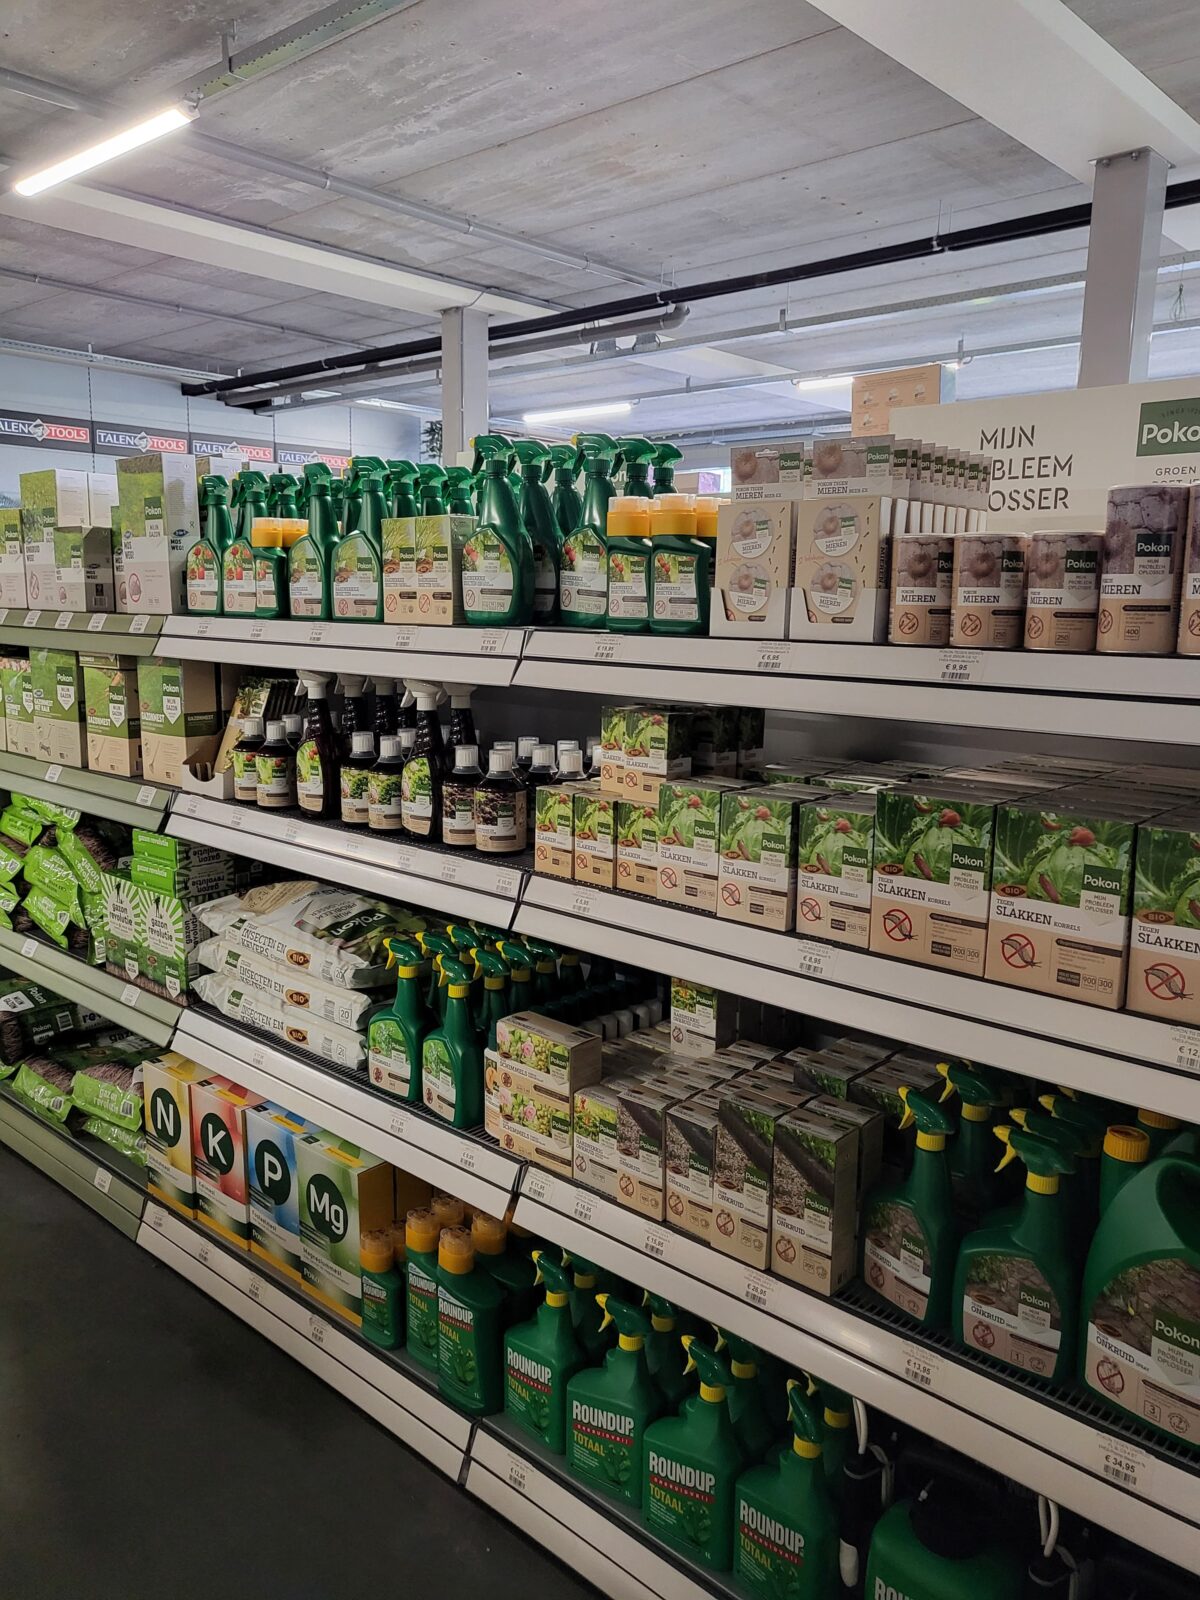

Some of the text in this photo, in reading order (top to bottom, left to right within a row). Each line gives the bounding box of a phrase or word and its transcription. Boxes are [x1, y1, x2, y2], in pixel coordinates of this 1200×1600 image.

[0, 421, 87, 440] ALEN TOOLS
[98, 432, 185, 451] TALEN TOOLS
[980, 424, 1036, 451] MIJN
[193, 443, 271, 459] TALEN TOOLS
[867, 453, 889, 461] Pokon
[280, 452, 309, 464] TALEN
[780, 459, 800, 468] Pokon
[991, 453, 1073, 481] BLEEM
[1155, 465, 1197, 476] GROEN
[735, 491, 764, 500] MIEREN
[817, 486, 848, 495] MIEREN
[988, 487, 1069, 512] OSSER
[145, 506, 161, 516] Pokon
[825, 541, 848, 549] MIEREN
[1137, 542, 1170, 553] Pokon
[399, 552, 415, 560] Pokon
[433, 551, 448, 560] Pokon
[484, 551, 500, 560] Pokon
[583, 551, 600, 560] Pokon
[1066, 559, 1096, 569] Pokon
[1101, 585, 1142, 595] MIEREN
[820, 598, 842, 607] MIEREN
[901, 594, 936, 603] MIEREN
[963, 595, 1000, 604] MIEREN
[1030, 596, 1063, 605] MIEREN
[1125, 628, 1139, 636] 400
[952, 664, 968, 672] 9,95
[56, 673, 73, 682] Pokon
[162, 683, 180, 693] Pokon
[109, 692, 124, 701] Pokon
[650, 741, 665, 749] Pokon
[601, 753, 622, 763] SLAKKEN
[626, 759, 649, 768] SLAKKEN
[641, 833, 656, 841] Pokon
[694, 826, 715, 837] Pokon
[536, 834, 557, 844] SLAKKEN
[762, 839, 785, 850] Pokon
[576, 842, 597, 852] SLAKKEN
[619, 849, 641, 860] SLAKKEN
[660, 850, 692, 864] SLAKKEN
[843, 853, 867, 865] Pokon
[952, 853, 984, 867] Pokon
[722, 866, 758, 880] SLAKKEN
[885, 865, 898, 873] BIO
[878, 876, 894, 884] TEGEN
[953, 876, 979, 885] PROBLEEM
[1083, 874, 1120, 890] Pokon
[801, 879, 839, 895] SLAKKEN
[877, 883, 927, 901] SLAKKEN
[1004, 886, 1020, 895] BIO
[112, 903, 128, 914] gazon
[996, 898, 1015, 907] TEGEN
[1084, 899, 1115, 909] PROBLEEM
[1084, 905, 1114, 915] OPLOSSER
[109, 911, 133, 926] revolutie
[996, 905, 1081, 932] SLAKKEN KORRELS
[1148, 913, 1165, 922] BIO
[150, 918, 168, 930] gazon
[331, 912, 386, 936] Pokon
[1138, 925, 1160, 934] TEGEN
[148, 926, 174, 942] revolutie
[241, 928, 287, 954] INSECTEN EN
[292, 953, 304, 963] BIO
[953, 947, 966, 956] 900
[966, 949, 980, 958] 300
[808, 956, 822, 965] 8,95
[239, 965, 273, 988] INSECTEN
[274, 980, 285, 994] EN
[1082, 976, 1097, 985] 900
[1098, 979, 1113, 989] 300
[27, 987, 47, 1005] Pokon
[292, 993, 304, 1003] BIO
[241, 1004, 284, 1031] INSECTEN EN
[340, 1009, 350, 1020] 20
[33, 1024, 52, 1033] Pokon
[551, 1056, 567, 1067] Pokon
[156, 1097, 174, 1137] N
[552, 1120, 569, 1131] Pokon
[600, 1125, 617, 1136] Pokon
[207, 1123, 227, 1166] K
[640, 1140, 658, 1152] Pokon
[263, 1151, 282, 1187] P
[689, 1158, 709, 1172] Pokon
[745, 1172, 767, 1186] Pokon
[717, 1192, 745, 1210] ONKRUID
[805, 1197, 830, 1213] Pokon
[309, 1184, 344, 1235] Mg
[776, 1217, 806, 1236] ONKRUID
[902, 1237, 924, 1256] Pokon
[408, 1273, 437, 1294] ROUNDUP
[363, 1283, 387, 1299] ROUNDUP
[409, 1292, 429, 1312] TOTAAL
[1020, 1291, 1050, 1309] Pokon
[438, 1298, 473, 1324] ROUNDUP
[970, 1305, 1006, 1326] ONKRUID
[439, 1320, 460, 1343] TOTAAL
[1155, 1319, 1200, 1350] Pokon
[1096, 1335, 1135, 1364] ONKRUID
[1168, 1346, 1184, 1357] MIJN
[1157, 1348, 1195, 1369] PROBLEEM
[507, 1346, 552, 1386] ROUNDUP
[906, 1358, 932, 1376] € 13,95
[1157, 1356, 1194, 1377] OPLOSSER
[508, 1374, 530, 1402] TOTAAL
[1149, 1405, 1156, 1415] 3
[572, 1400, 635, 1437] ROUNDUP
[572, 1429, 605, 1457] TOTAAL
[1105, 1454, 1136, 1474] € 34,95
[649, 1450, 716, 1494] ROUNDUP
[649, 1483, 684, 1514] TOTAAL
[740, 1499, 805, 1555] ROUNDUP
[740, 1531, 774, 1572] TOTAAL
